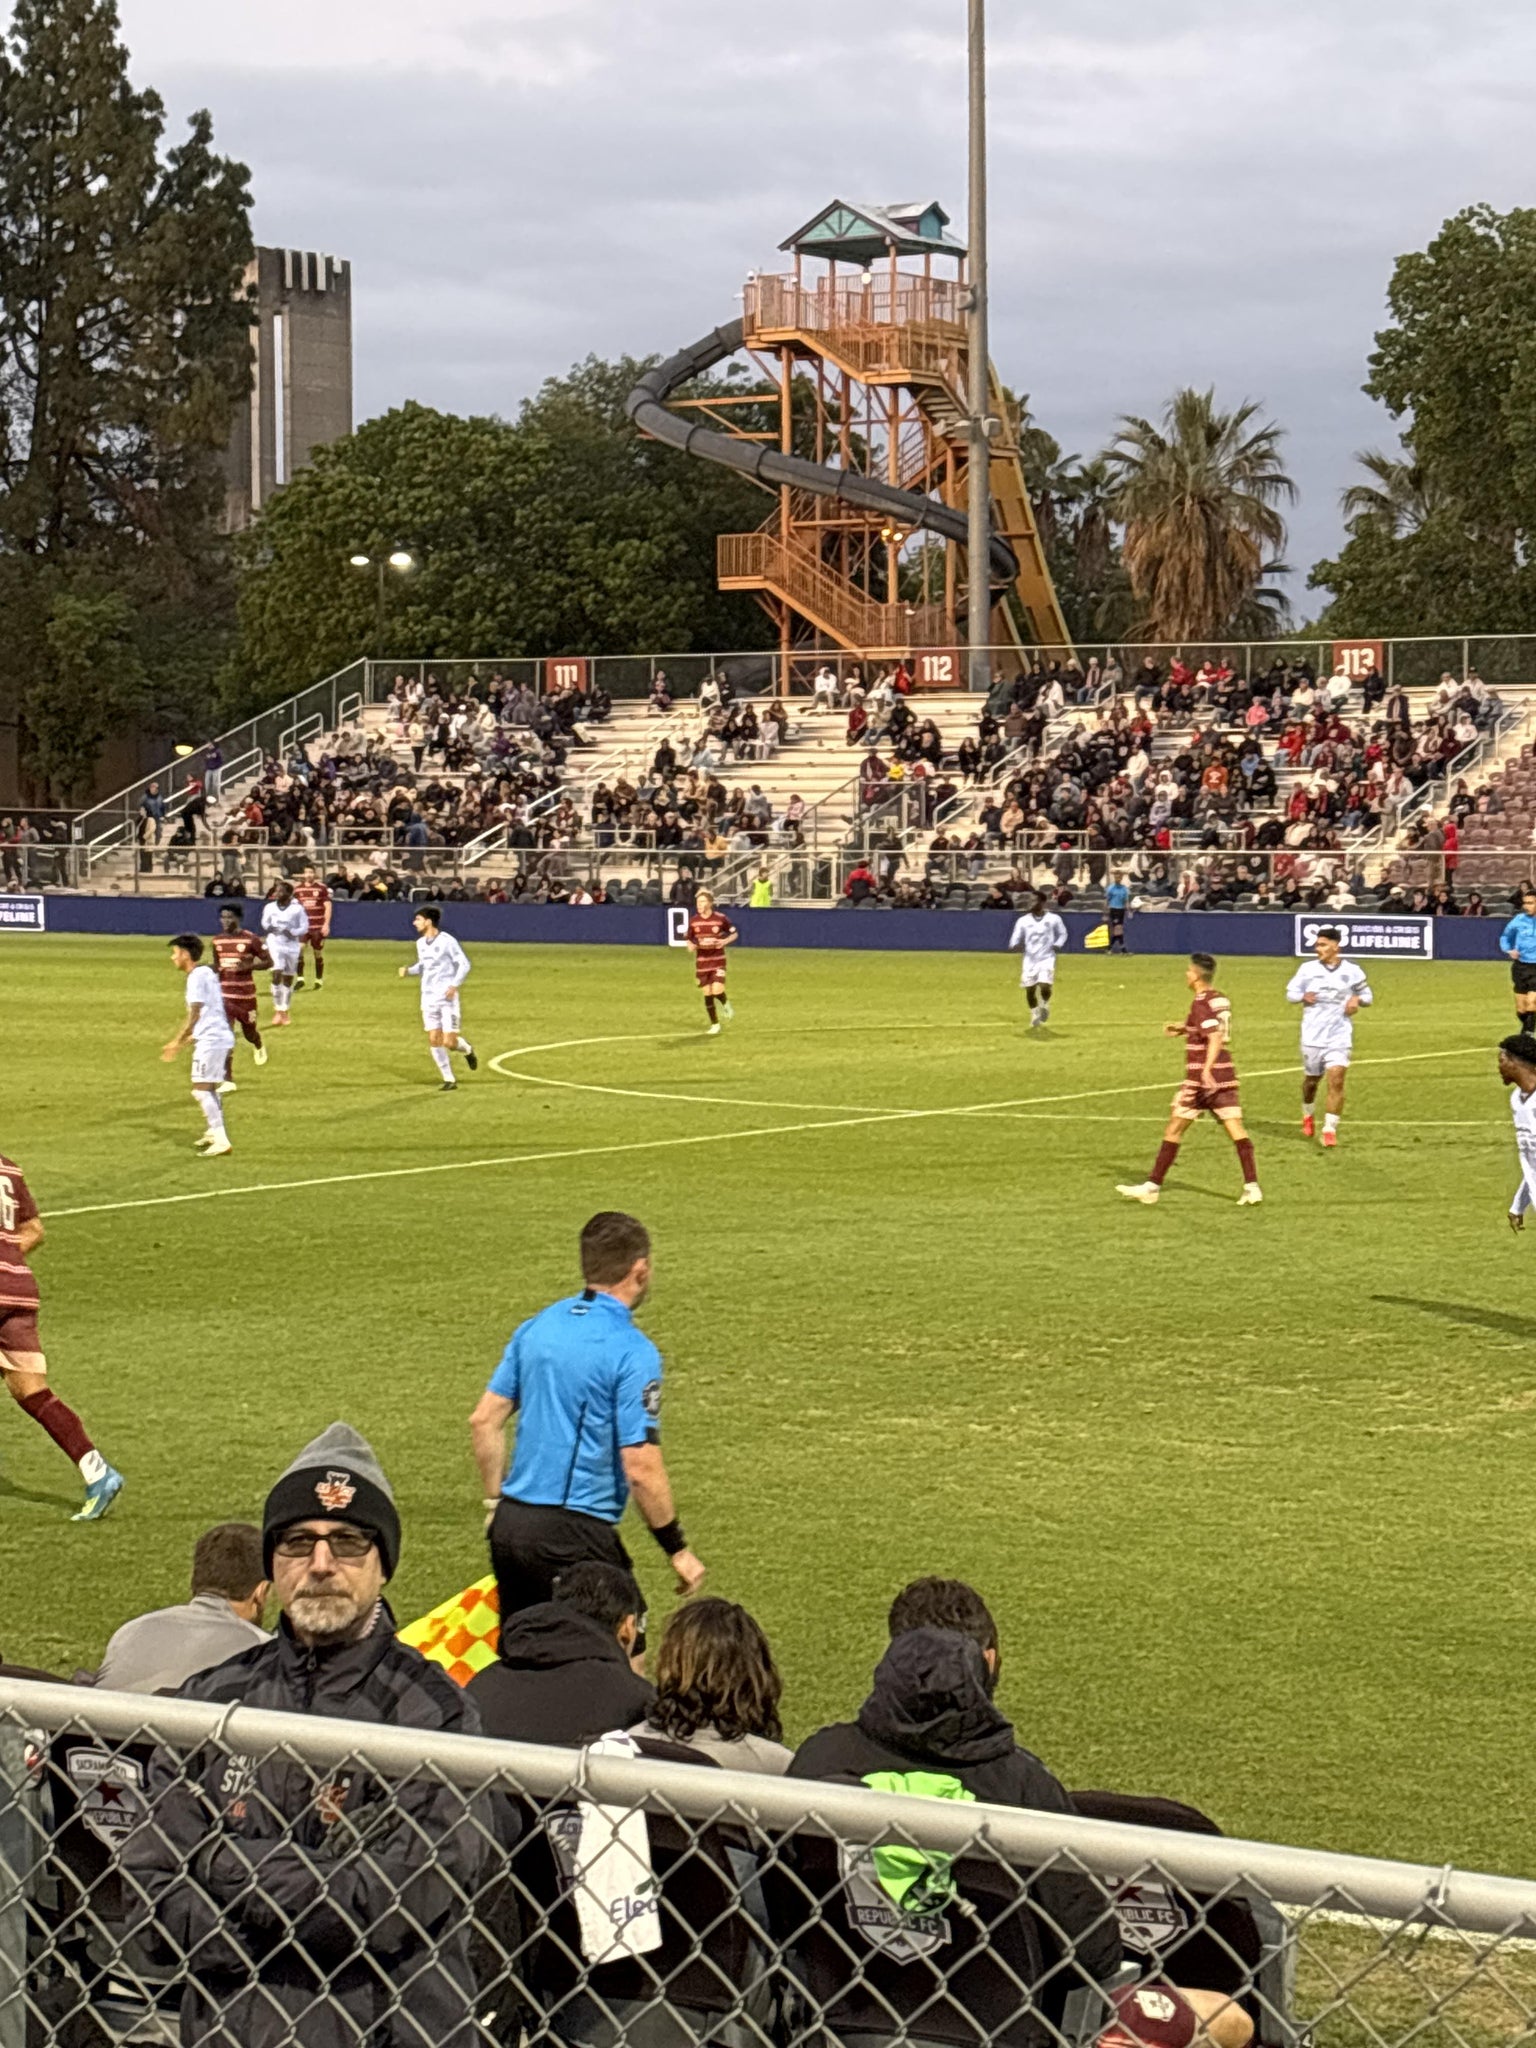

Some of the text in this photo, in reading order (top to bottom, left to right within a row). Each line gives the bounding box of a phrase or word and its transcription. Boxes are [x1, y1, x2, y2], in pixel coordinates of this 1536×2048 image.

[921, 655, 953, 682] 112
[1341, 648, 1375, 676] 113
[554, 664, 578, 689] 111
[1350, 935, 1421, 949] LIFELINE
[920, 1918, 938, 1935] FC
[1157, 1911, 1176, 1924] FC
